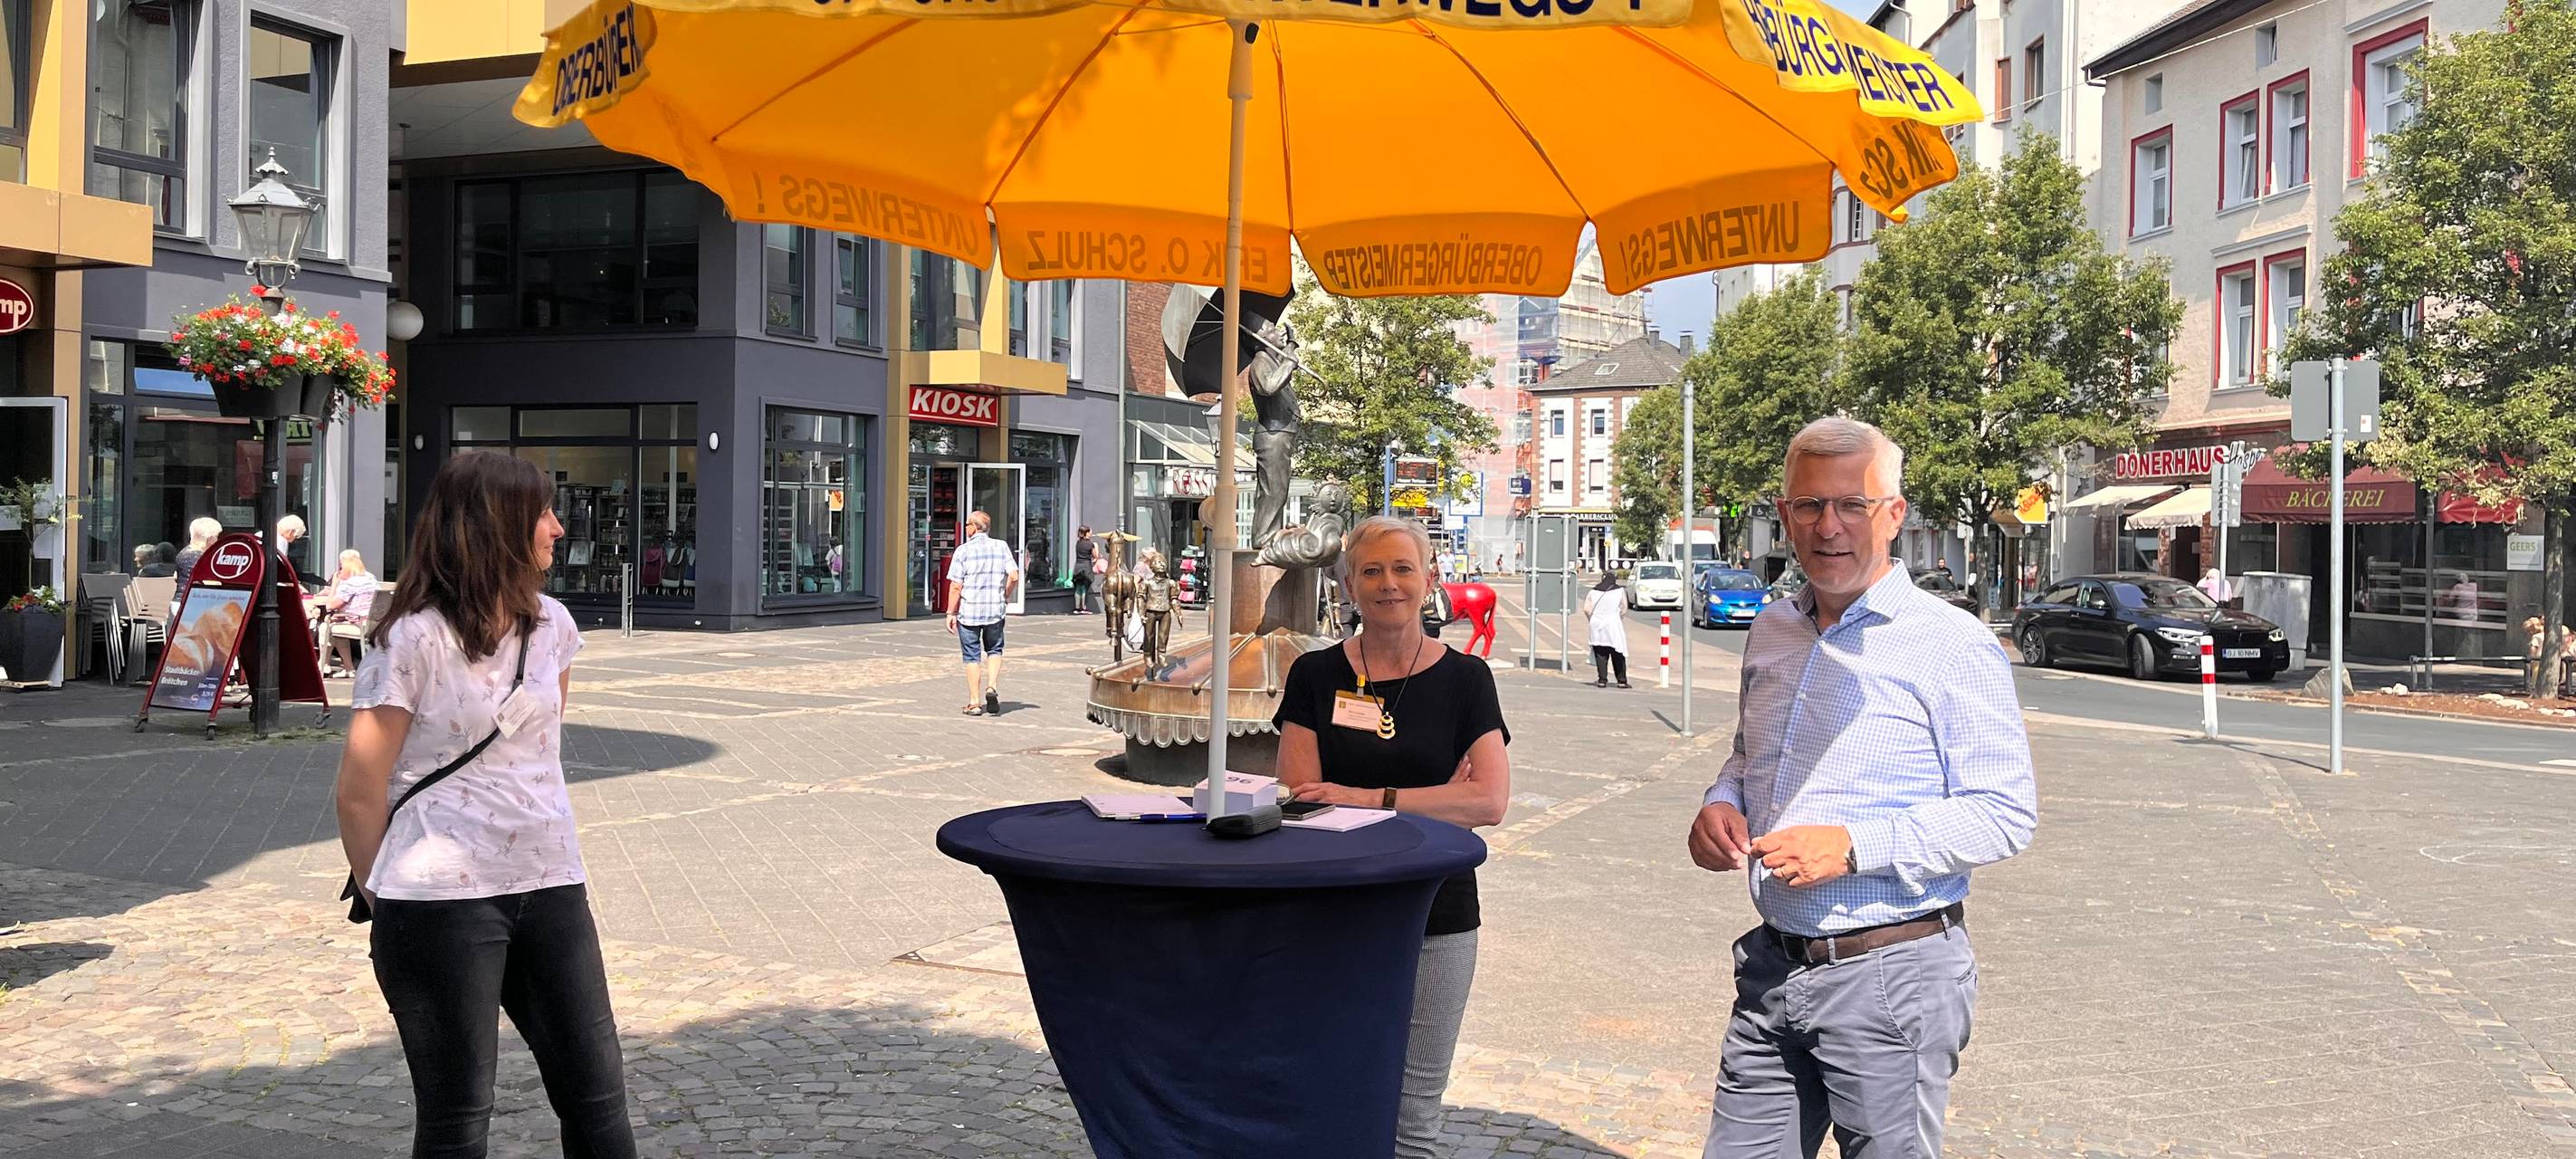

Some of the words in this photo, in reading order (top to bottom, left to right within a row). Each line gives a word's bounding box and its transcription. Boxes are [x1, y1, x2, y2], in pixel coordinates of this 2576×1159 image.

[0, 298, 27, 329] mp
[911, 388, 996, 419] KIOSK
[2116, 445, 2226, 478] DÖNERHAUS
[2509, 541, 2536, 551] GEERS
[216, 550, 250, 575] kamp
